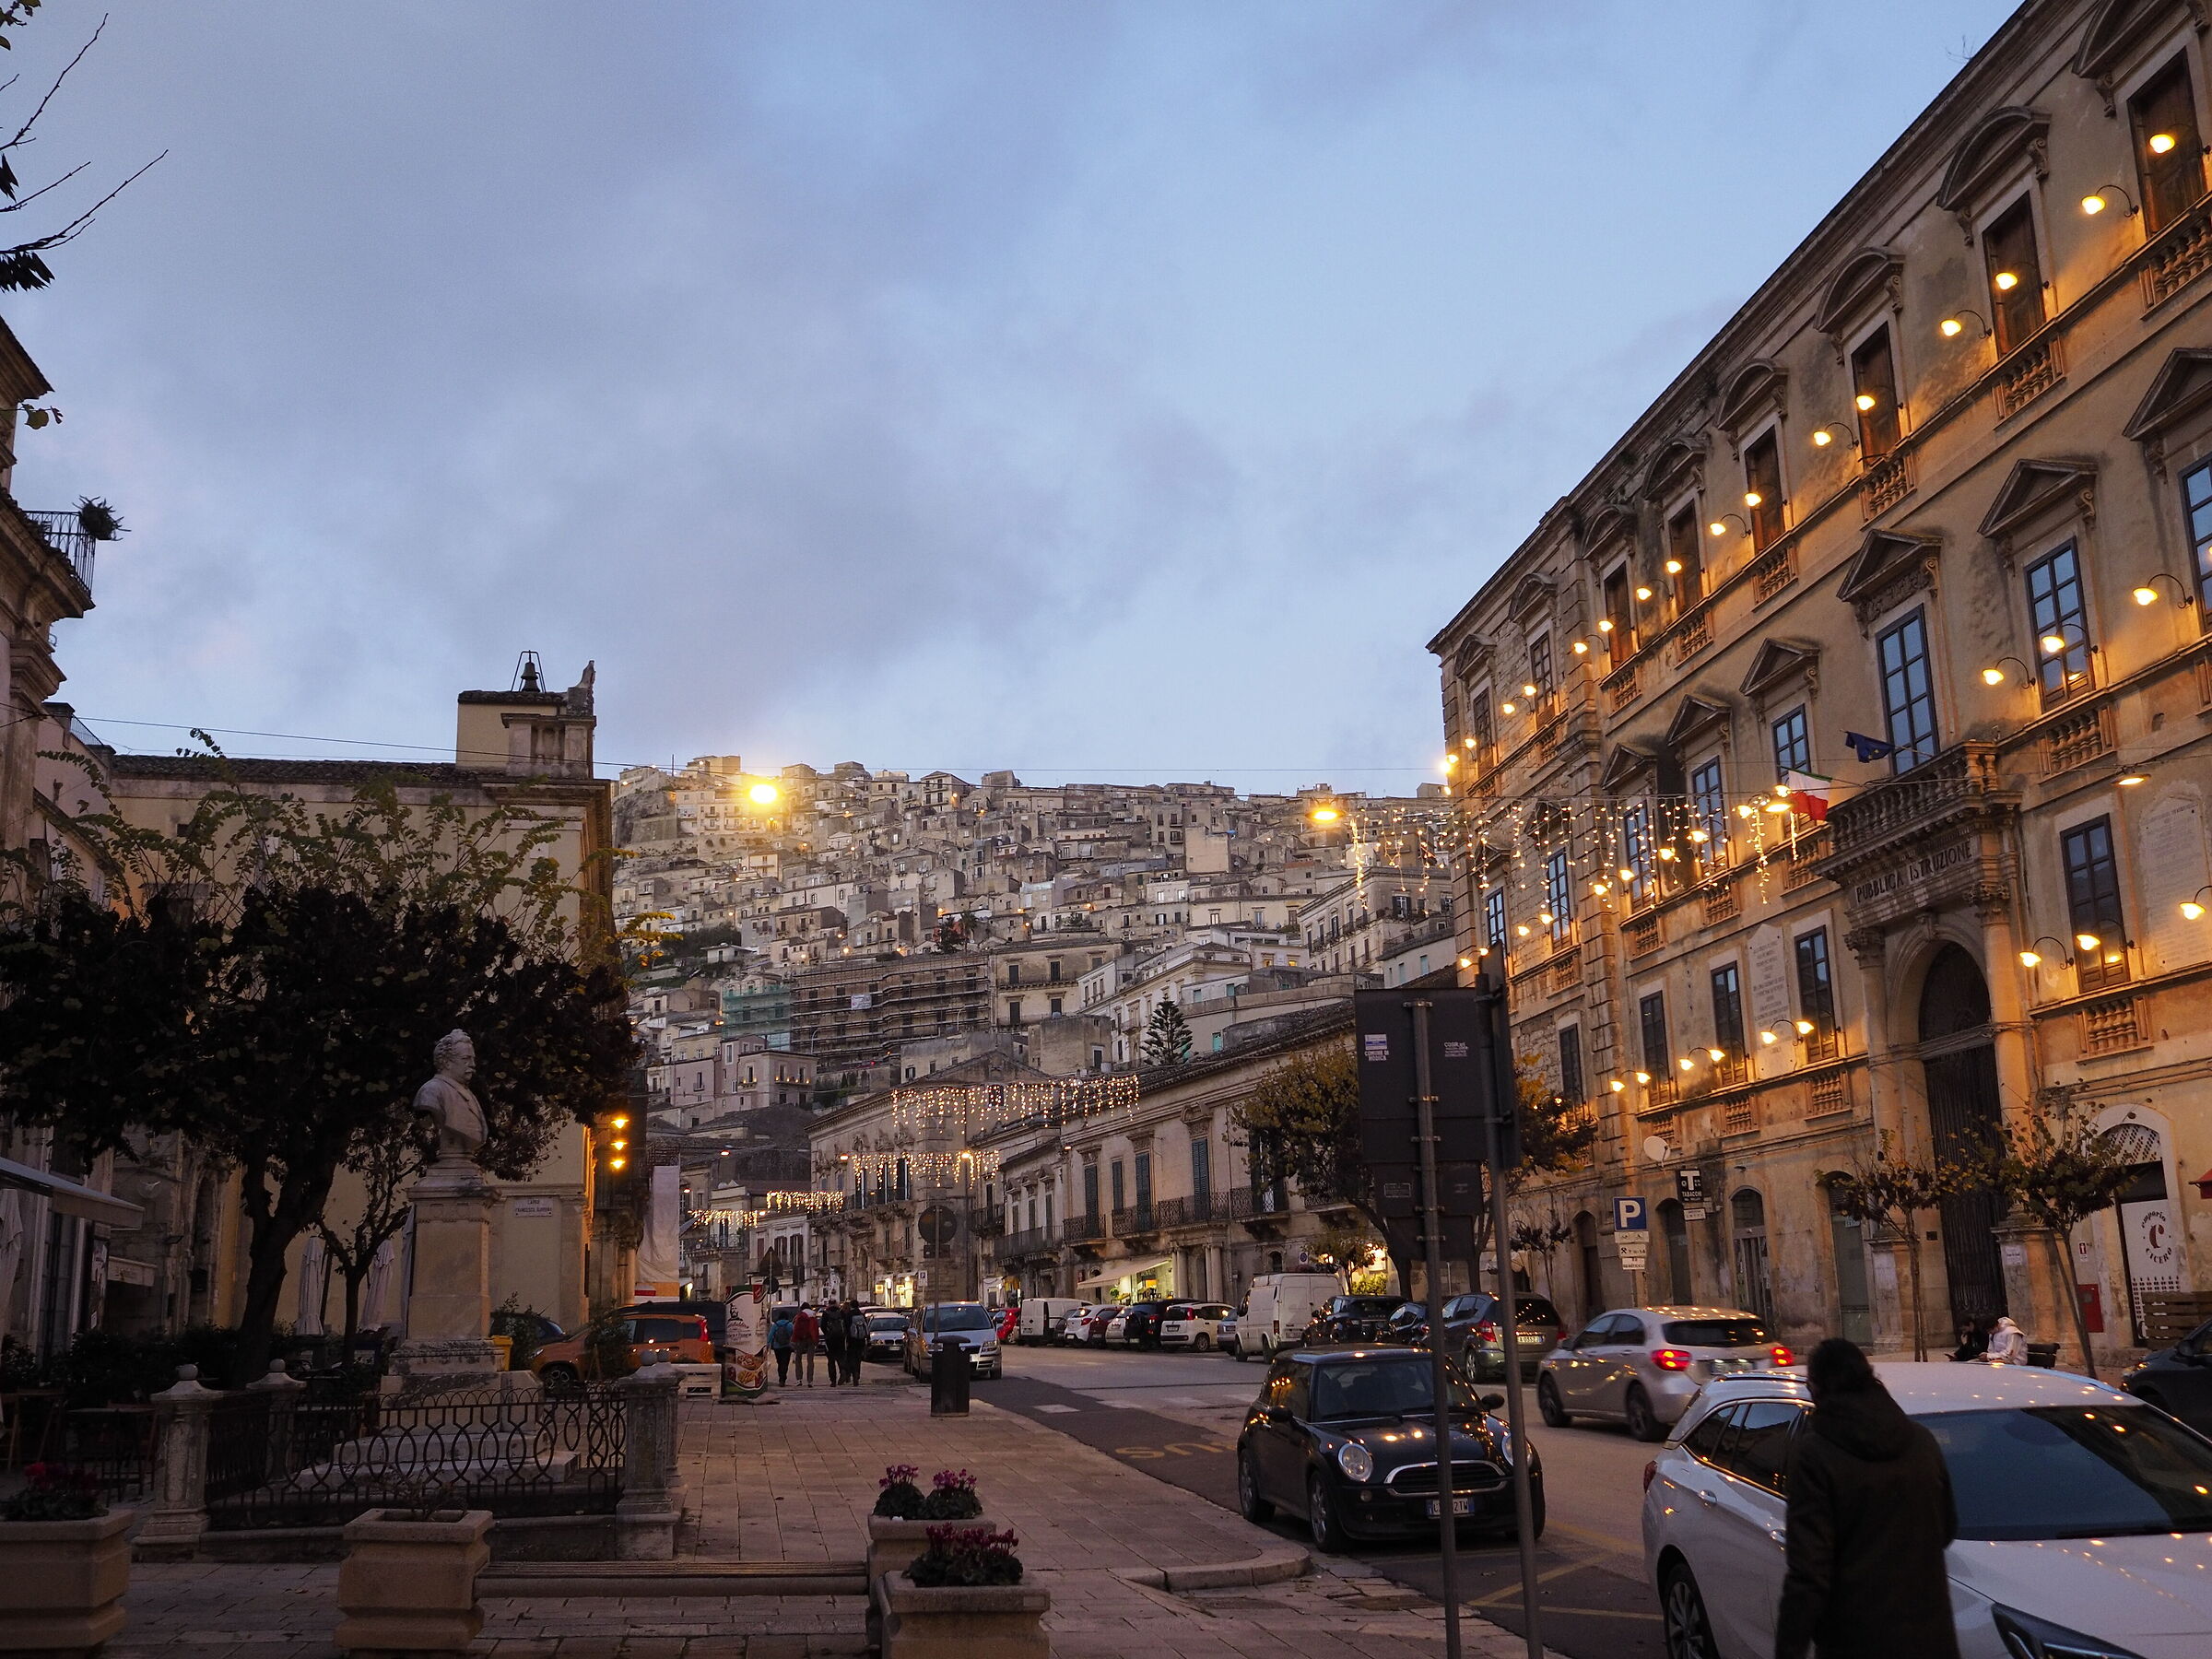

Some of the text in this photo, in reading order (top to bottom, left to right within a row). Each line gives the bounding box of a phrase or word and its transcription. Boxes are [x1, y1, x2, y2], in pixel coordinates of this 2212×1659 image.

[1855, 840, 1973, 902] PUBBLICA ISTRUZIONE
[1680, 1171, 1700, 1191] T
[1619, 1200, 1641, 1228] P
[2141, 1211, 2167, 1229] emporio
[2146, 1247, 2172, 1265] CICERO
